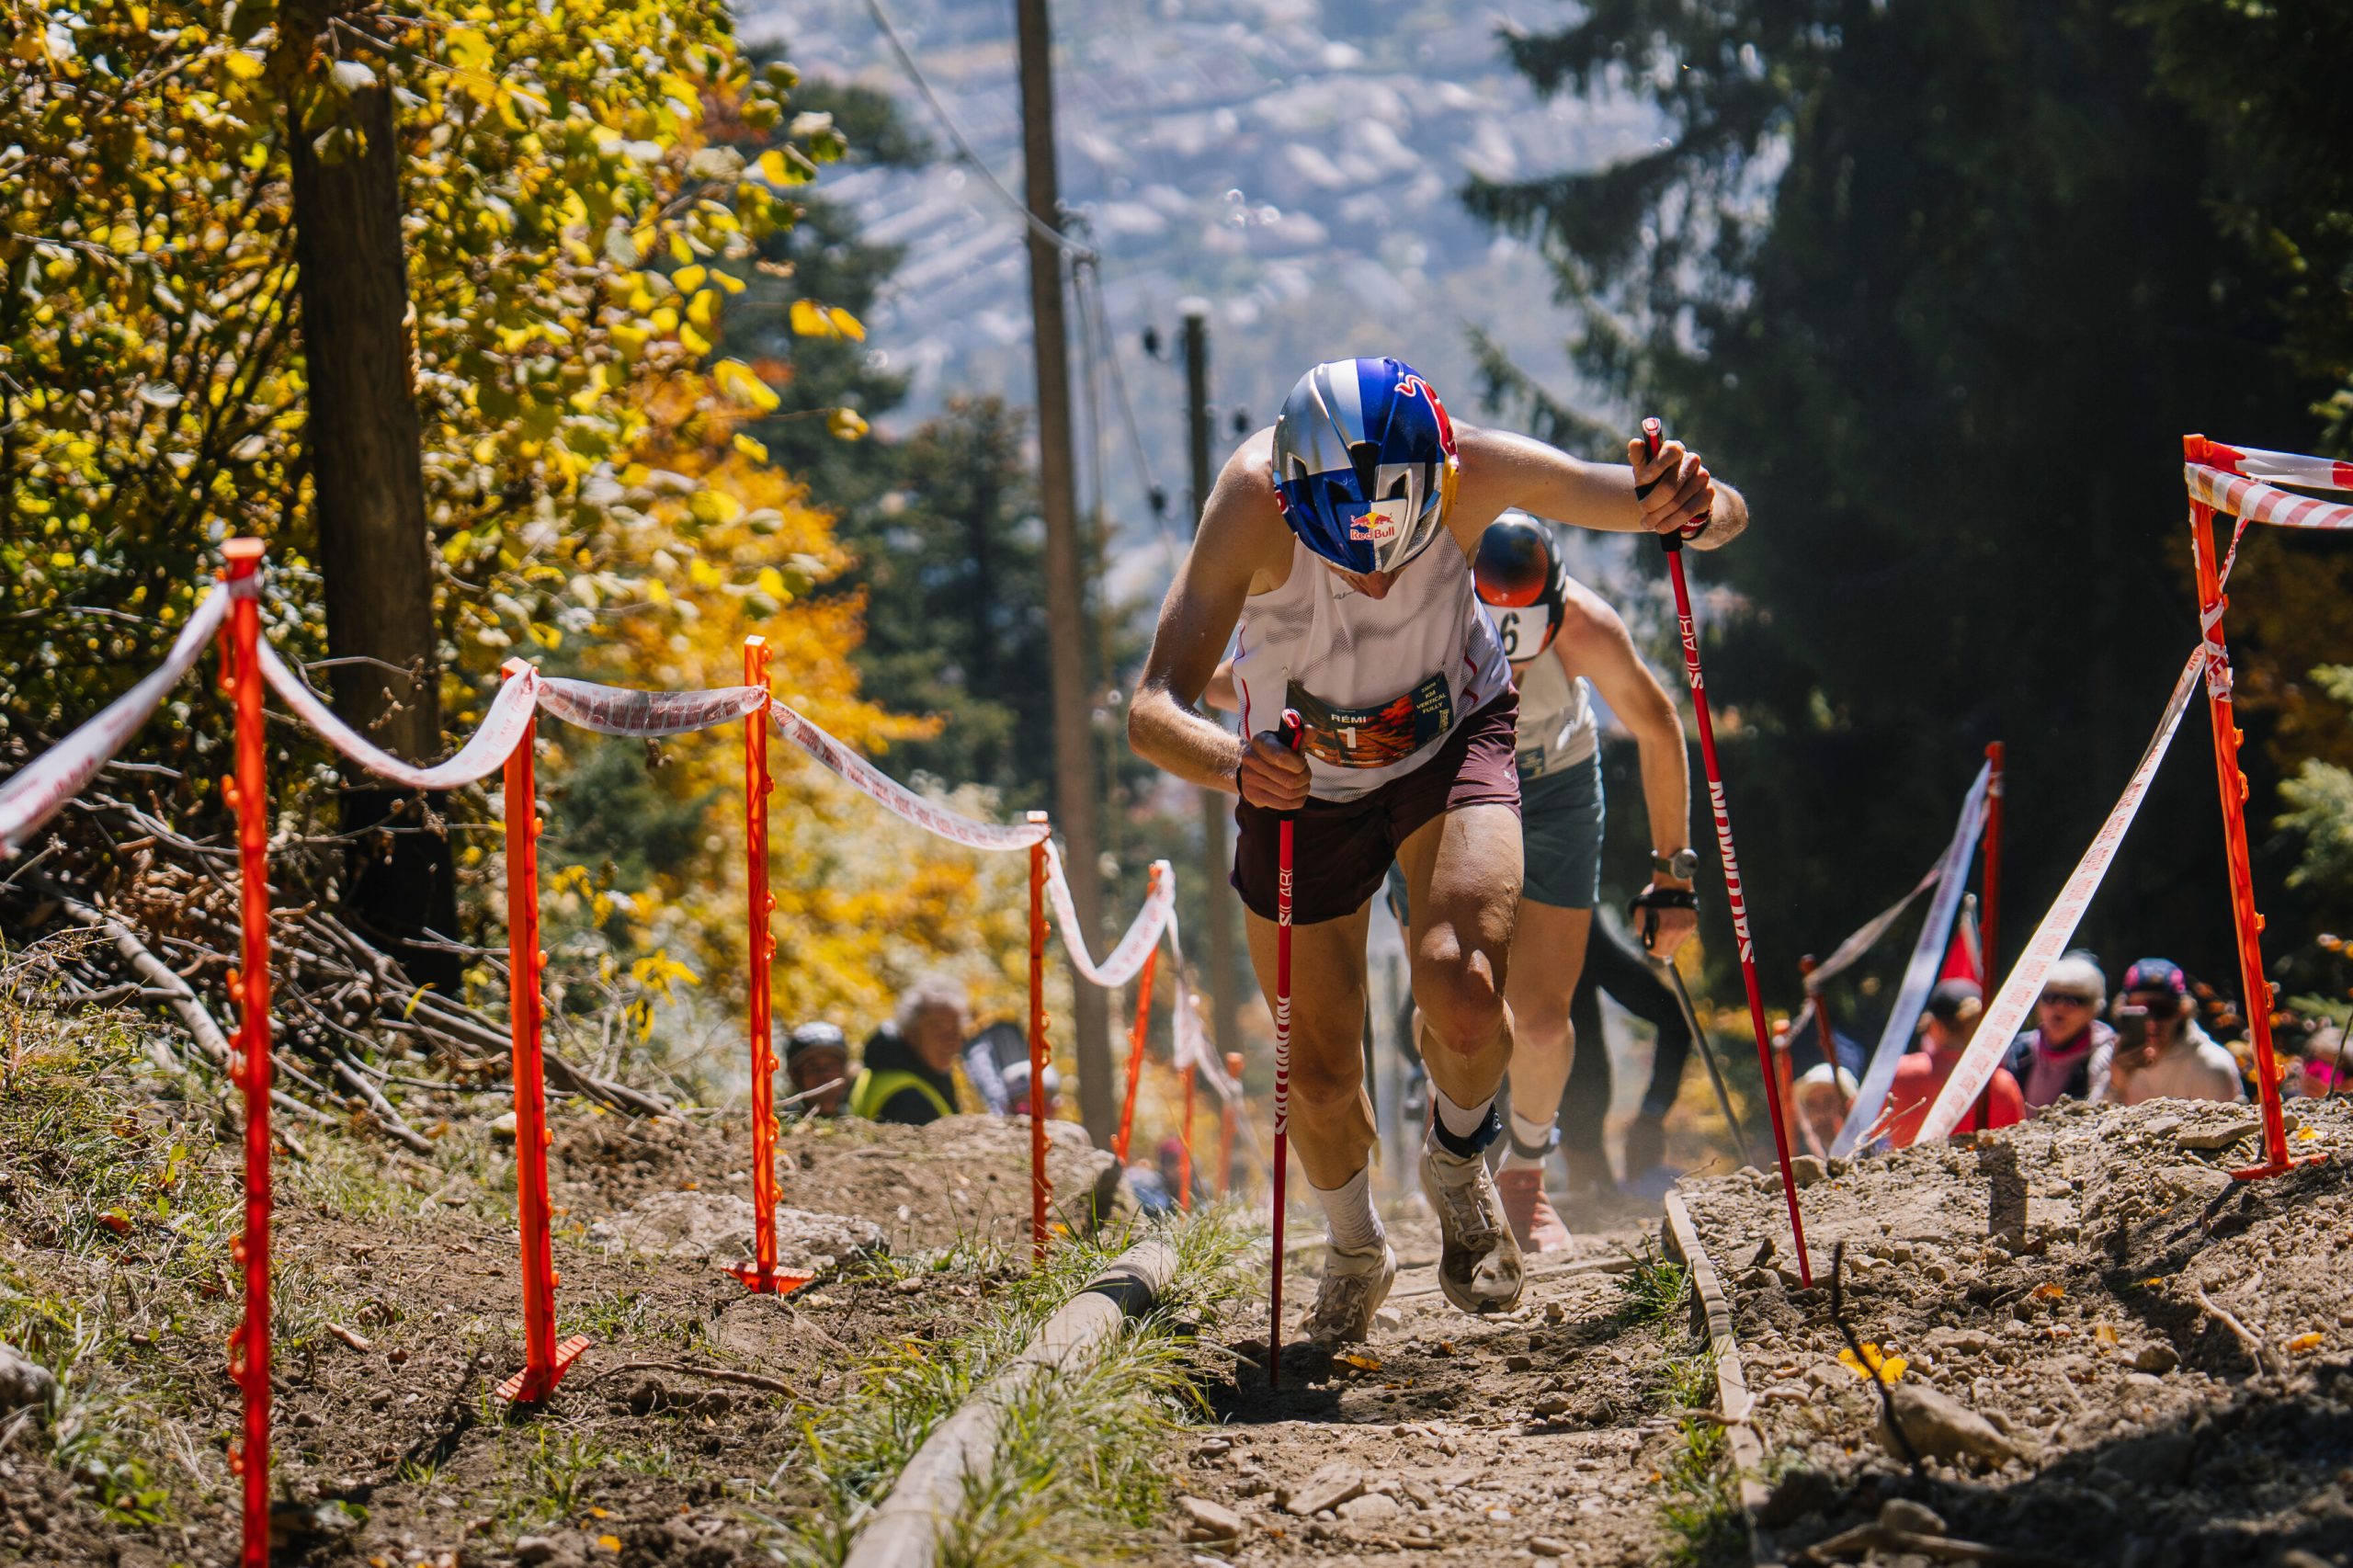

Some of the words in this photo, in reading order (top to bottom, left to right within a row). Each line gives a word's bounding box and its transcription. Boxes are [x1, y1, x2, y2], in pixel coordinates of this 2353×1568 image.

[1349, 528, 1373, 540] Red
[1374, 527, 1395, 540] Bull
[1500, 611, 1520, 656] 6
[1425, 689, 1437, 699] KM
[1416, 692, 1447, 710] VERTICAL
[1422, 701, 1443, 714] FULLY
[1330, 713, 1367, 723] RÉMI
[1336, 726, 1357, 749] 1
